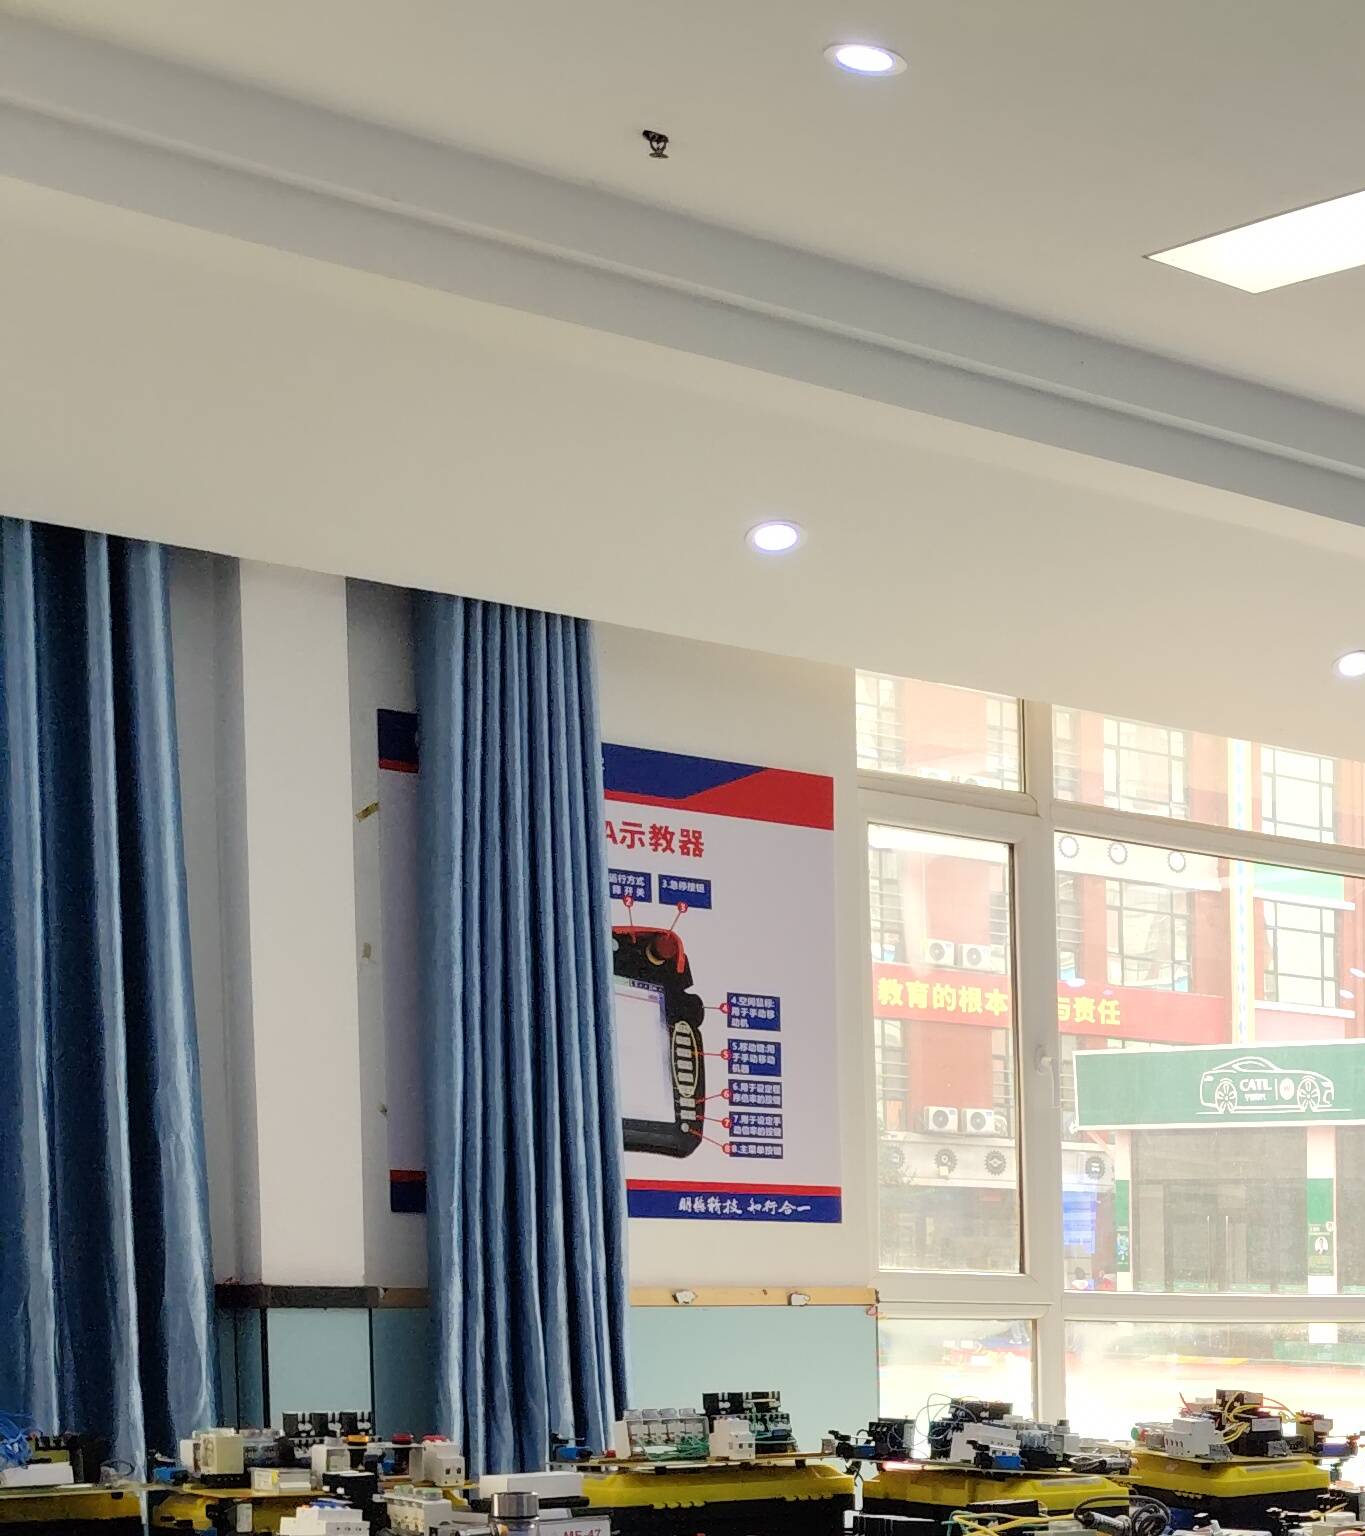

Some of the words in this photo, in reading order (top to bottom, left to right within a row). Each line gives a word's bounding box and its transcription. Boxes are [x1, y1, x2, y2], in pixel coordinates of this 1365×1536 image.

[878, 977, 1009, 1016] 教育的根本
[1239, 1078, 1273, 1091] CATL
